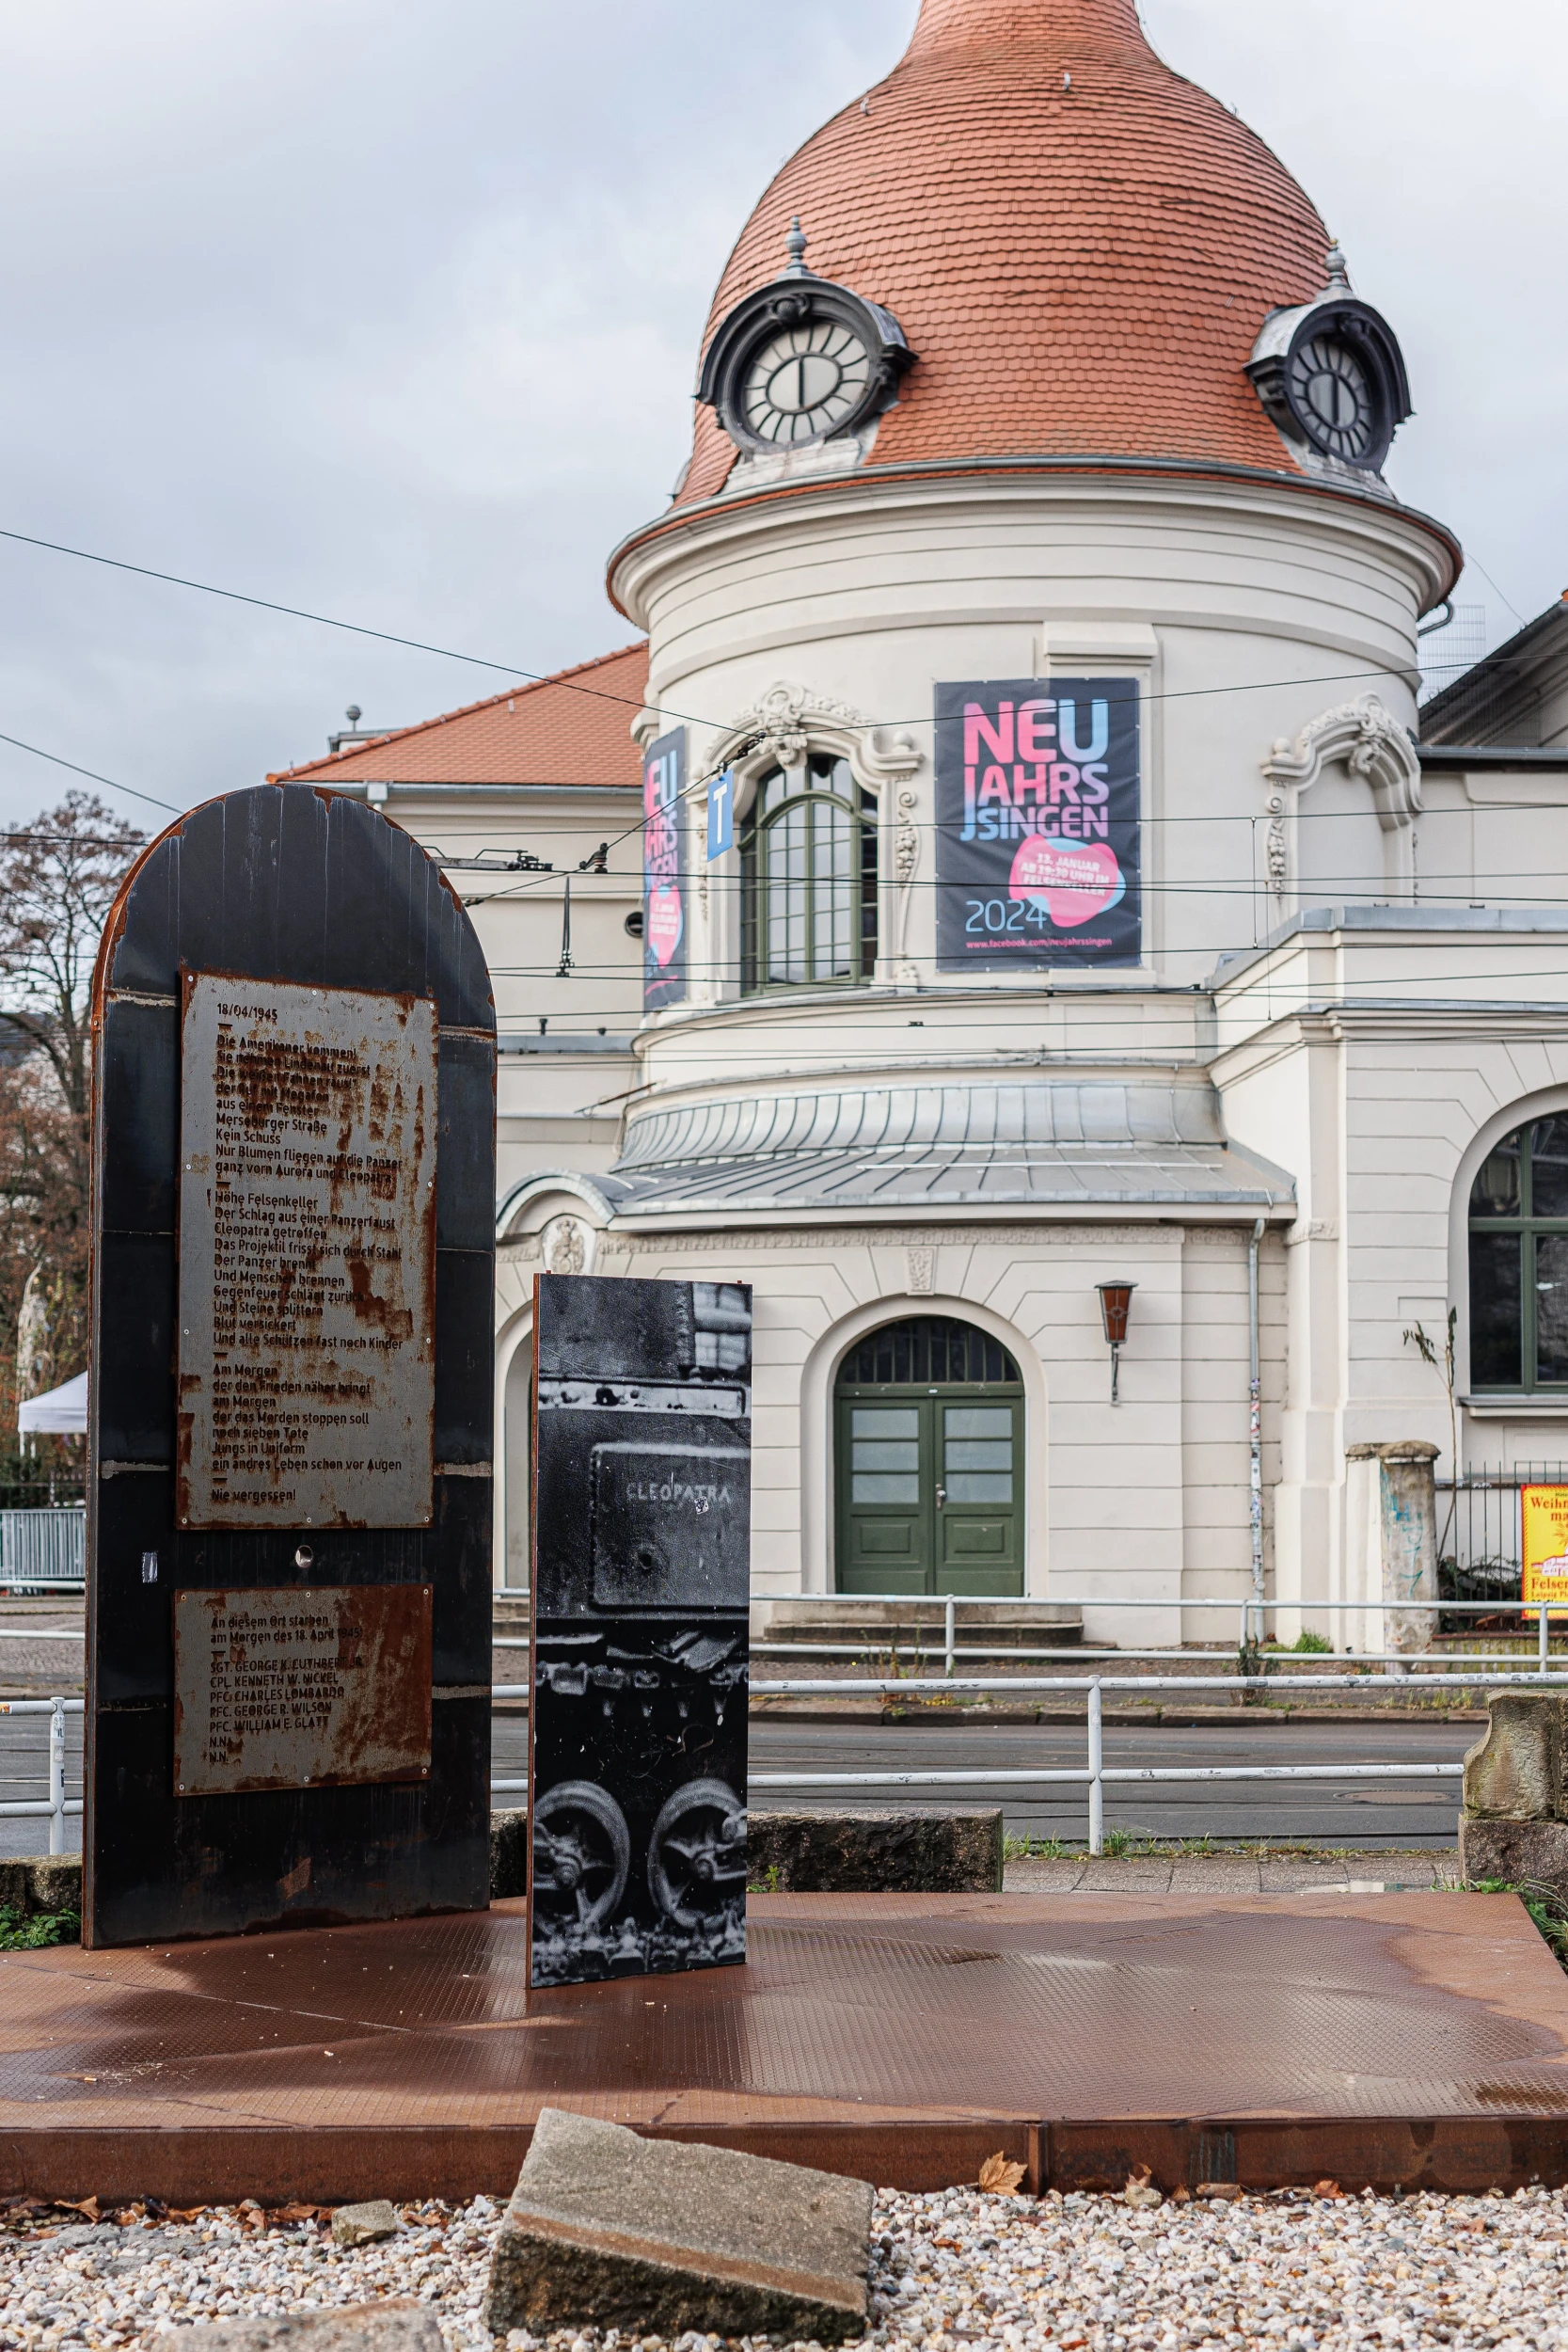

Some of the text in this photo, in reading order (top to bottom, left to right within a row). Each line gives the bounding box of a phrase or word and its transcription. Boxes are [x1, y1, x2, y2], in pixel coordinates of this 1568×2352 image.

[964, 699, 1109, 765] NEU
[977, 805, 1109, 841] SINGEN
[1056, 856, 1100, 872] JANUAR
[1069, 869, 1094, 882] UHR
[965, 898, 1047, 932] 2024
[217, 1003, 277, 1020] 18/04/1945
[216, 1035, 356, 1057] Die Amerikaner kommen!
[217, 1050, 232, 1063] Sie
[284, 1057, 333, 1073] Lindenau
[337, 1063, 371, 1076] zuerst
[216, 1082, 235, 1093] der
[261, 1087, 277, 1098] mit
[282, 1087, 329, 1105] Megafon
[216, 1098, 319, 1117] aus einem Fenster
[216, 1114, 326, 1134] Merseburger Straße
[216, 1129, 280, 1145] Kein Schuss
[216, 1144, 403, 1169] Nur Blumen fliegen auf die Panzer
[215, 1161, 391, 1184] ganz vorn Aurora und Cleopatra
[215, 1189, 318, 1209] Höhe Felsenkeller
[215, 1207, 395, 1229] Der Schlag aus einer Panzerfaust
[214, 1223, 326, 1242] Cleopatra getroffen
[214, 1238, 402, 1259] Das Projektil frisst sich durch Stahl
[214, 1254, 316, 1270] Der Panzer brennt
[214, 1269, 344, 1287] Und Menschen brennen
[214, 1285, 363, 1303] Gegenfeuer schlägt zurück
[214, 1301, 323, 1318] Und Steine splittern
[214, 1316, 296, 1331] Blut versickert
[214, 1332, 403, 1350] Und alle Schützen fast noch Kinder
[214, 1363, 277, 1378] Am Morgen
[213, 1379, 371, 1397] der den Frieden näher bringt
[213, 1395, 276, 1410] am Morgen
[213, 1411, 370, 1427] der das Morden stoppen soll
[213, 1427, 309, 1439] noch sieben Tote
[212, 1442, 305, 1456] Jungs in Uniform
[213, 1458, 402, 1473] ein andres Leben schon vor Augen
[212, 1488, 295, 1503] Nie vergessen!
[626, 1482, 731, 1503] CLEOPATRA
[211, 1614, 328, 1629] An diesem Ort starben
[211, 1633, 227, 1644] am
[230, 1631, 271, 1645] Morgen
[274, 1630, 292, 1641] des
[294, 1629, 308, 1641] 18.
[310, 1629, 334, 1642] April
[211, 1661, 232, 1673] SGT.
[235, 1660, 277, 1672] GEORGE
[282, 1659, 291, 1669] K.
[293, 1657, 346, 1669] CUTHBERT
[235, 1676, 284, 1687] KENNETH
[287, 1675, 301, 1685] W.
[303, 1672, 339, 1684] NICKEL
[210, 1687, 344, 1704] PFC. CHARLES LOMBARDO
[235, 1705, 277, 1716] GEORGE
[279, 1704, 289, 1714] R.
[292, 1701, 331, 1714] WILSON
[210, 1721, 231, 1732] PFC.
[235, 1719, 280, 1731] WILLIAM
[294, 1716, 328, 1728] GLATT
[209, 1752, 229, 1763] N.N.
